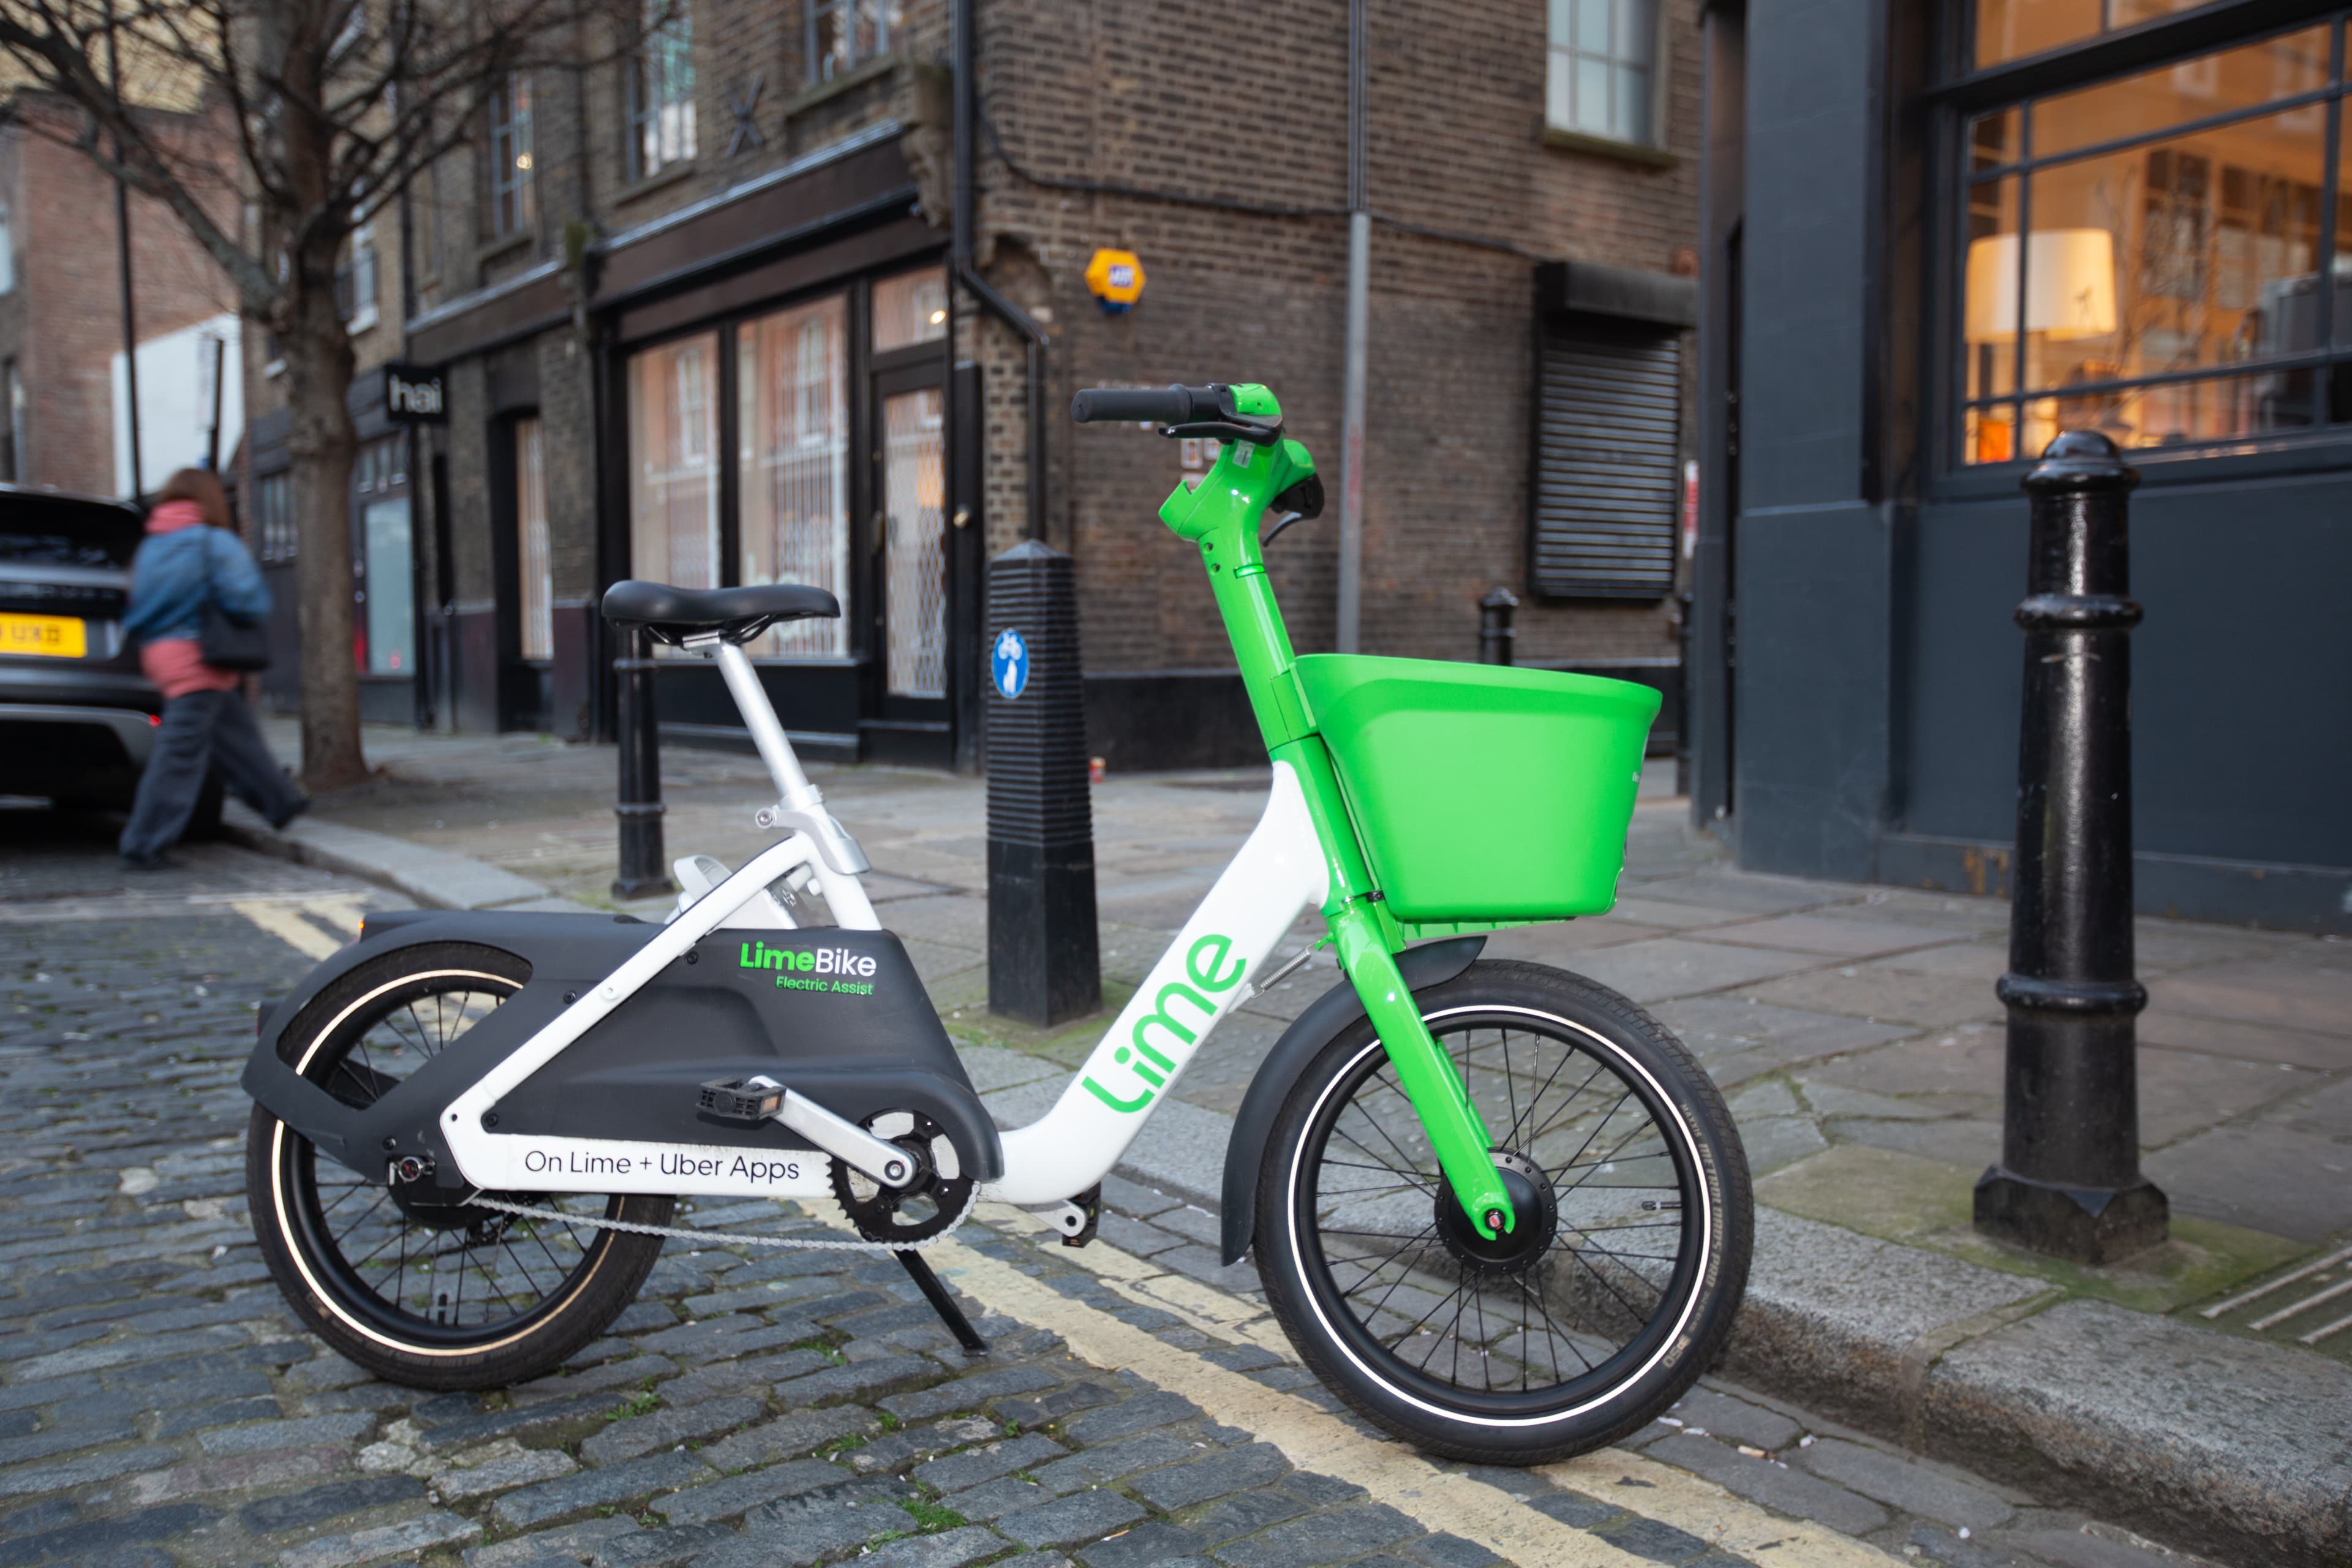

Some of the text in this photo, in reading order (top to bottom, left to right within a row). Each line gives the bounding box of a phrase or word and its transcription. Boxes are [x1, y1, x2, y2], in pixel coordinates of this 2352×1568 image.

[388, 374, 442, 414] hai
[739, 941, 877, 977] LimeBike
[775, 975, 873, 996] Electric Assist
[1081, 934, 1247, 1114] Lime
[525, 1150, 799, 1184] On Lime + Uber Apps
[1705, 1253, 1721, 1287] PRO
